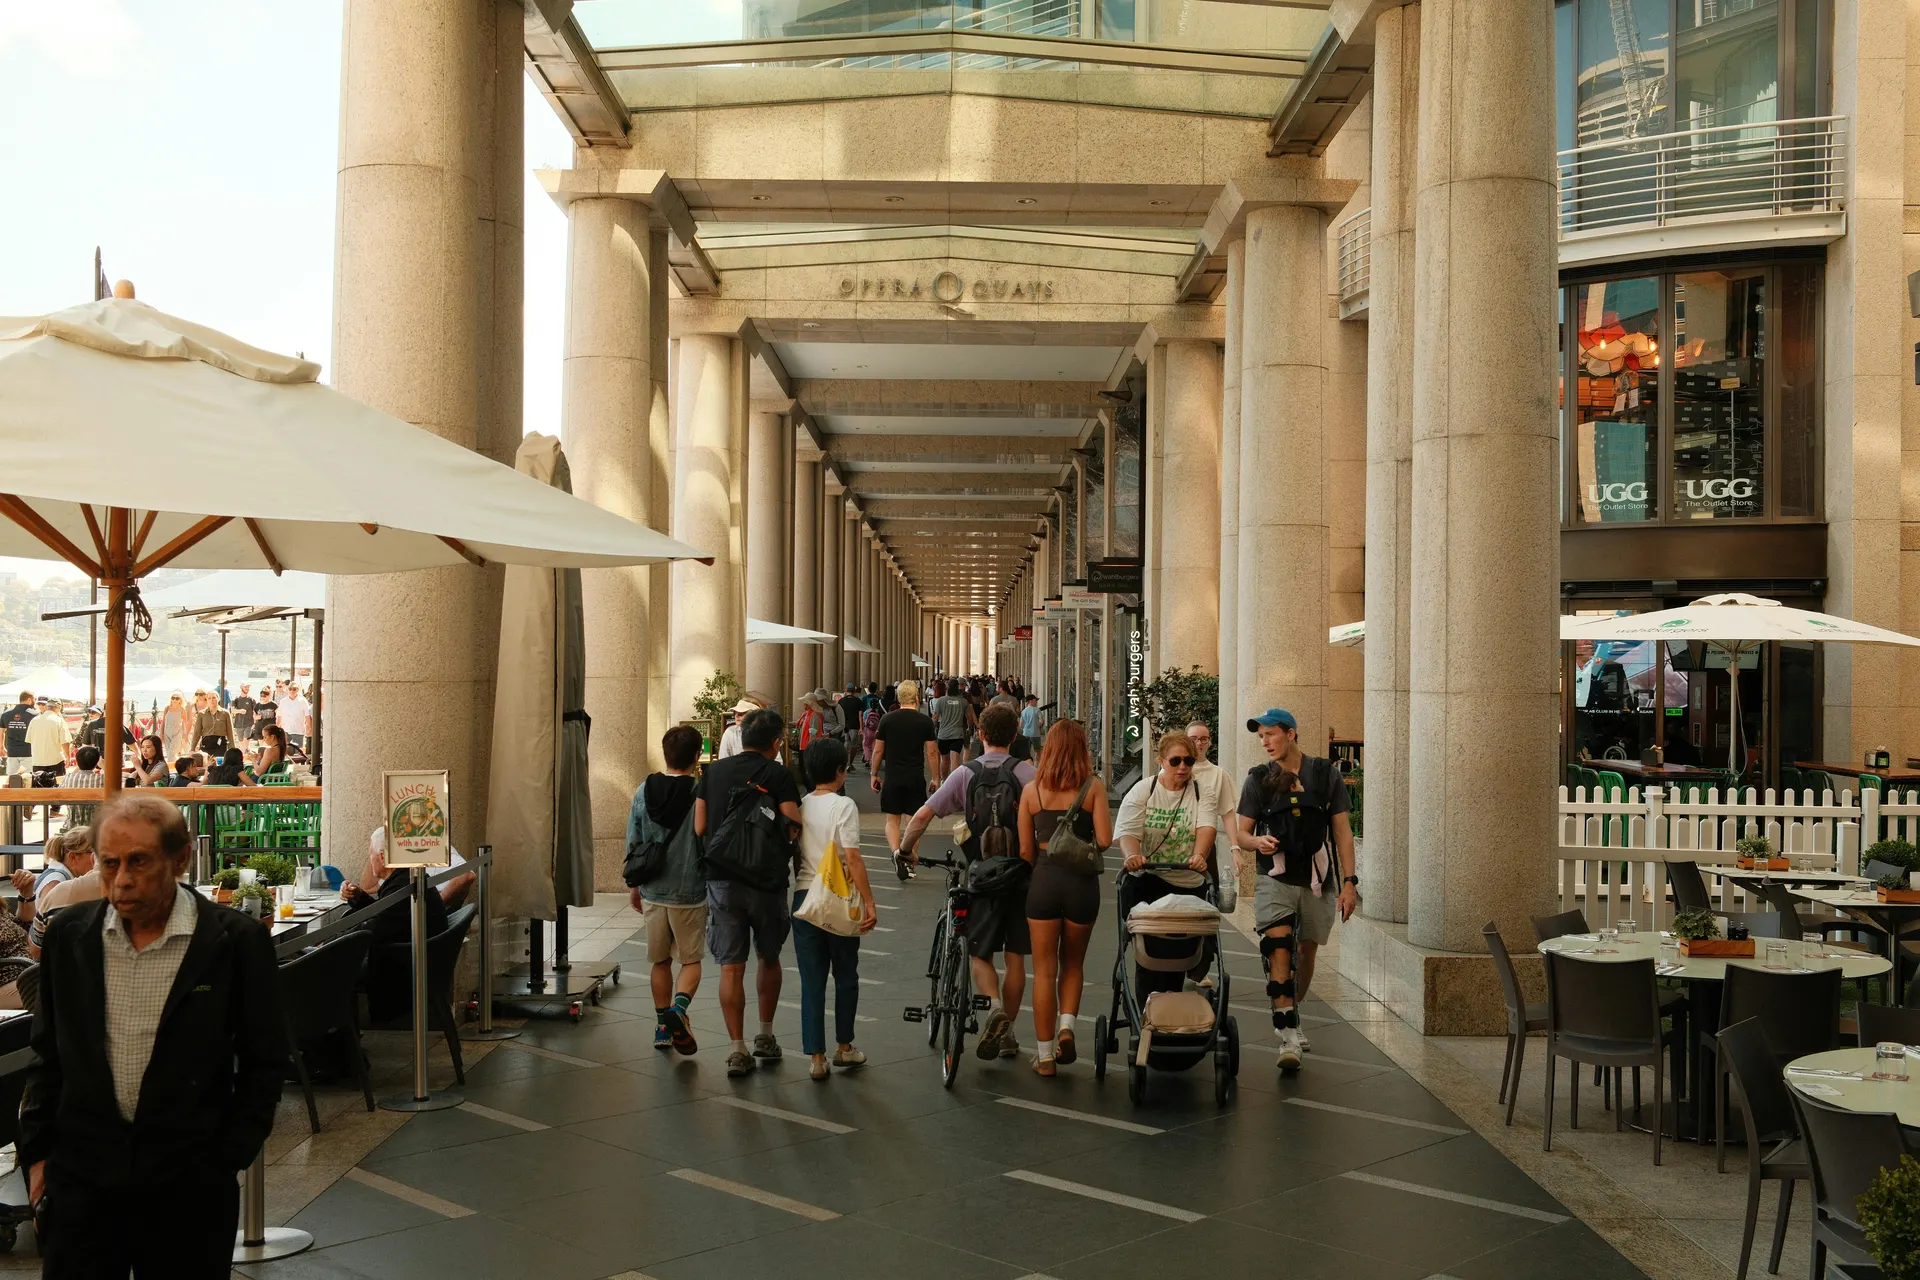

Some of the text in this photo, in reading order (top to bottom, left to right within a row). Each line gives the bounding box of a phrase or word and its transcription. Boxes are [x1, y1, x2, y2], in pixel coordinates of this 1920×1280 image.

[839, 278, 922, 293] OPERA
[973, 279, 1054, 296] QUAYS
[1588, 482, 1648, 502] UGG
[1685, 478, 1753, 499] UGG
[1127, 630, 1142, 718] wahburgers
[390, 784, 434, 804] LUNCH
[420, 838, 440, 847] Drink
